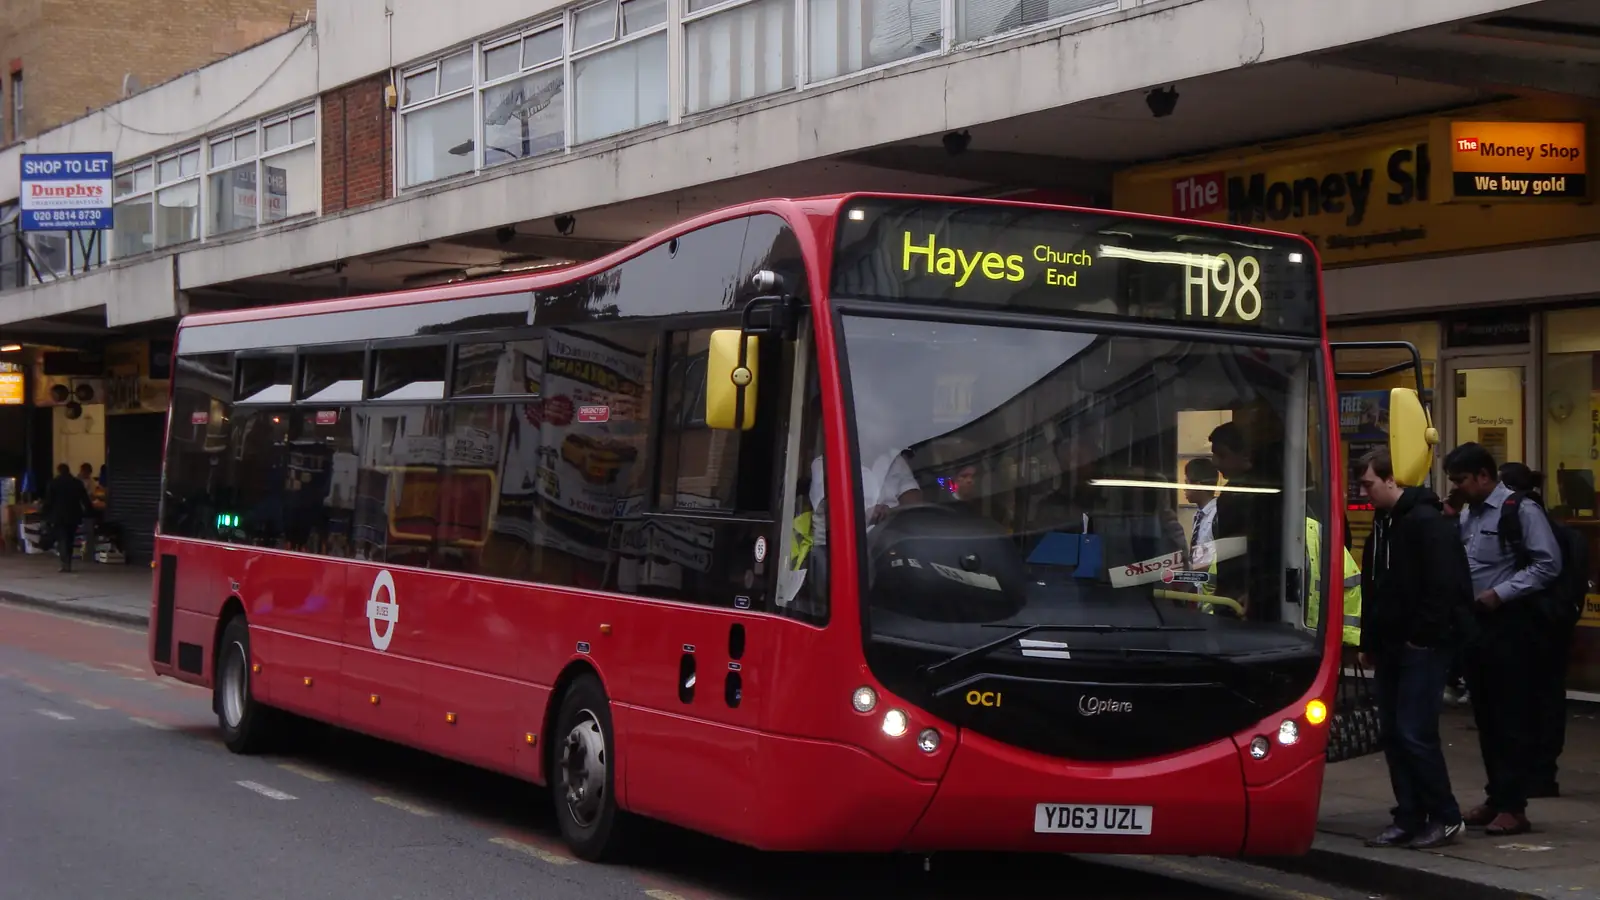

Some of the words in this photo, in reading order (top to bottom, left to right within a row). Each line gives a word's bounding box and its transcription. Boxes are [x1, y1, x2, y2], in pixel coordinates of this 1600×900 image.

[1458, 140, 1477, 150] The
[1480, 142, 1535, 161] Money
[1540, 143, 1580, 161] Shop
[24, 161, 61, 174] SHOP
[64, 160, 81, 173] TO
[85, 159, 108, 172] LET
[31, 184, 103, 198] Dunphys
[1475, 176, 1498, 191] We
[1501, 176, 1529, 194] buy
[1532, 177, 1565, 195] gold
[1176, 176, 1220, 212] The
[1228, 168, 1373, 227] Money
[33, 211, 51, 220] 020
[53, 211, 76, 220] 8814
[79, 210, 101, 219] 8730
[903, 231, 1025, 288] Hayes
[1033, 244, 1092, 267] Church
[1046, 268, 1077, 287] End
[1185, 253, 1262, 321] H98
[1341, 396, 1362, 413] FREE
[1079, 694, 1133, 716] Optare
[1045, 806, 1098, 829] YD63
[1103, 807, 1143, 830] UZL
